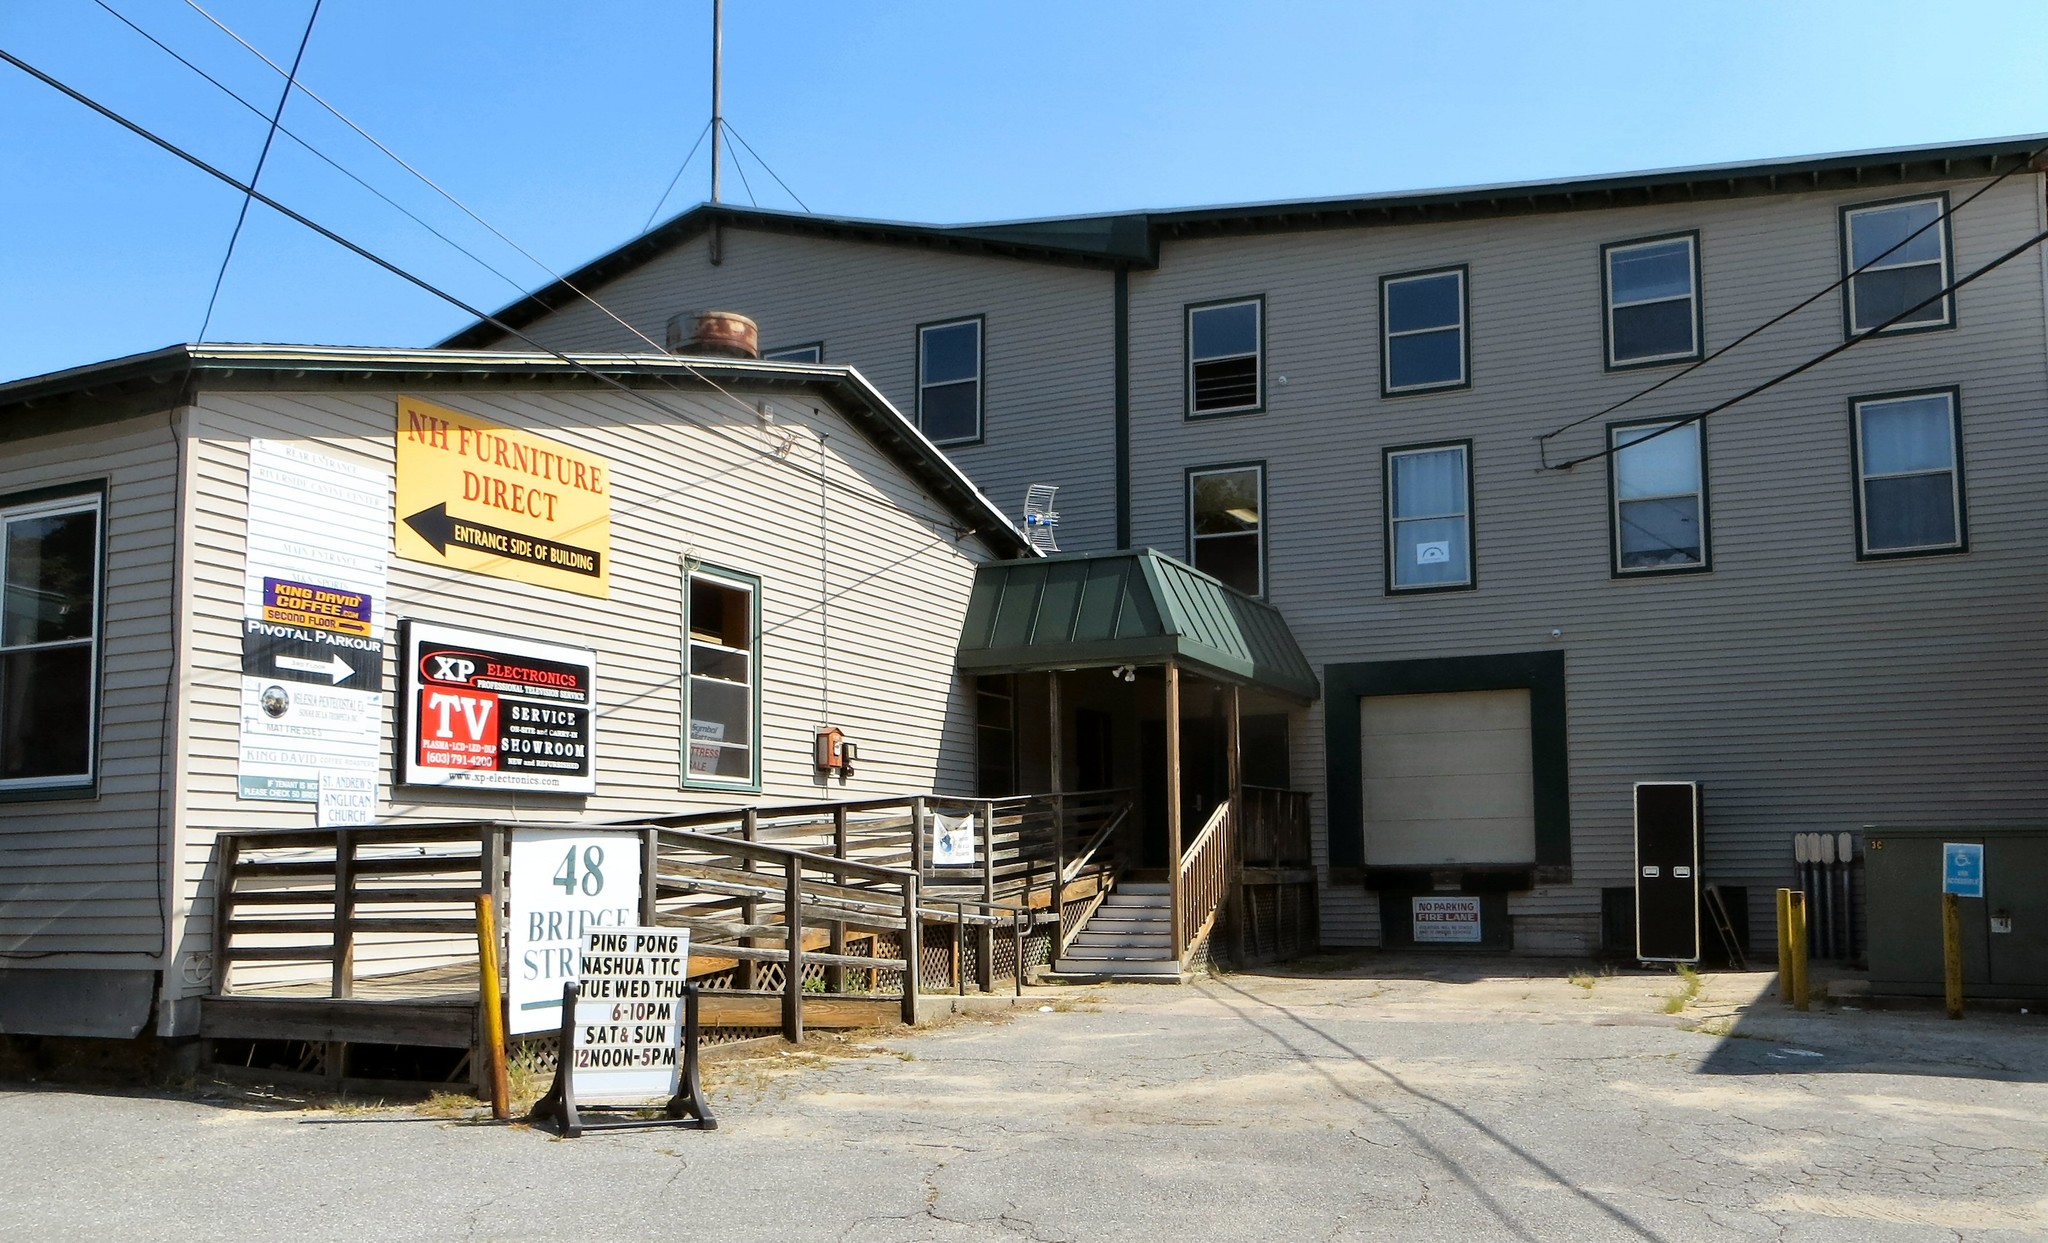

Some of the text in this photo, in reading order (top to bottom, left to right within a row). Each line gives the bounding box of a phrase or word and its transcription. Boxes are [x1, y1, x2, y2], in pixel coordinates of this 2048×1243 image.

[407, 409, 604, 495] NH FURNITURE
[462, 470, 558, 522] DIRECT
[454, 524, 594, 572] ENTRANCE SIDE OF BUILDING
[274, 583, 360, 608] KING DAVID
[308, 616, 337, 629] FLOOR
[247, 620, 381, 653] PIVOTAL PARKOUR
[433, 655, 576, 687] XP ELECTRONICS
[476, 680, 585, 701] PROFESSIONAL TELEVISION SERVICE
[428, 692, 494, 741] TV
[511, 706, 576, 726] SERVICE
[509, 725, 536, 735] ON-SITE
[246, 750, 277, 762] KING
[280, 751, 317, 764] DAVID
[501, 737, 585, 758] SHOWROOM
[426, 751, 493, 767] (603) 791-4200
[275, 780, 298, 788] TENANT
[335, 776, 372, 790] ANDREW'S
[449, 773, 560, 787] www.xp-electronics.com
[244, 788, 268, 797] PLEASE
[269, 789, 291, 798] CHECK
[323, 793, 372, 808] ANGLICAN
[328, 809, 366, 822] CHURCH
[552, 844, 605, 897] 48
[1418, 902, 1475, 911] NO PARKING
[1418, 913, 1476, 921] FIRE LANE
[590, 933, 678, 954] PING PONG
[581, 956, 681, 976] NASHUA TTC
[580, 979, 685, 998] TUE WED THU
[634, 1025, 666, 1044] SUN
